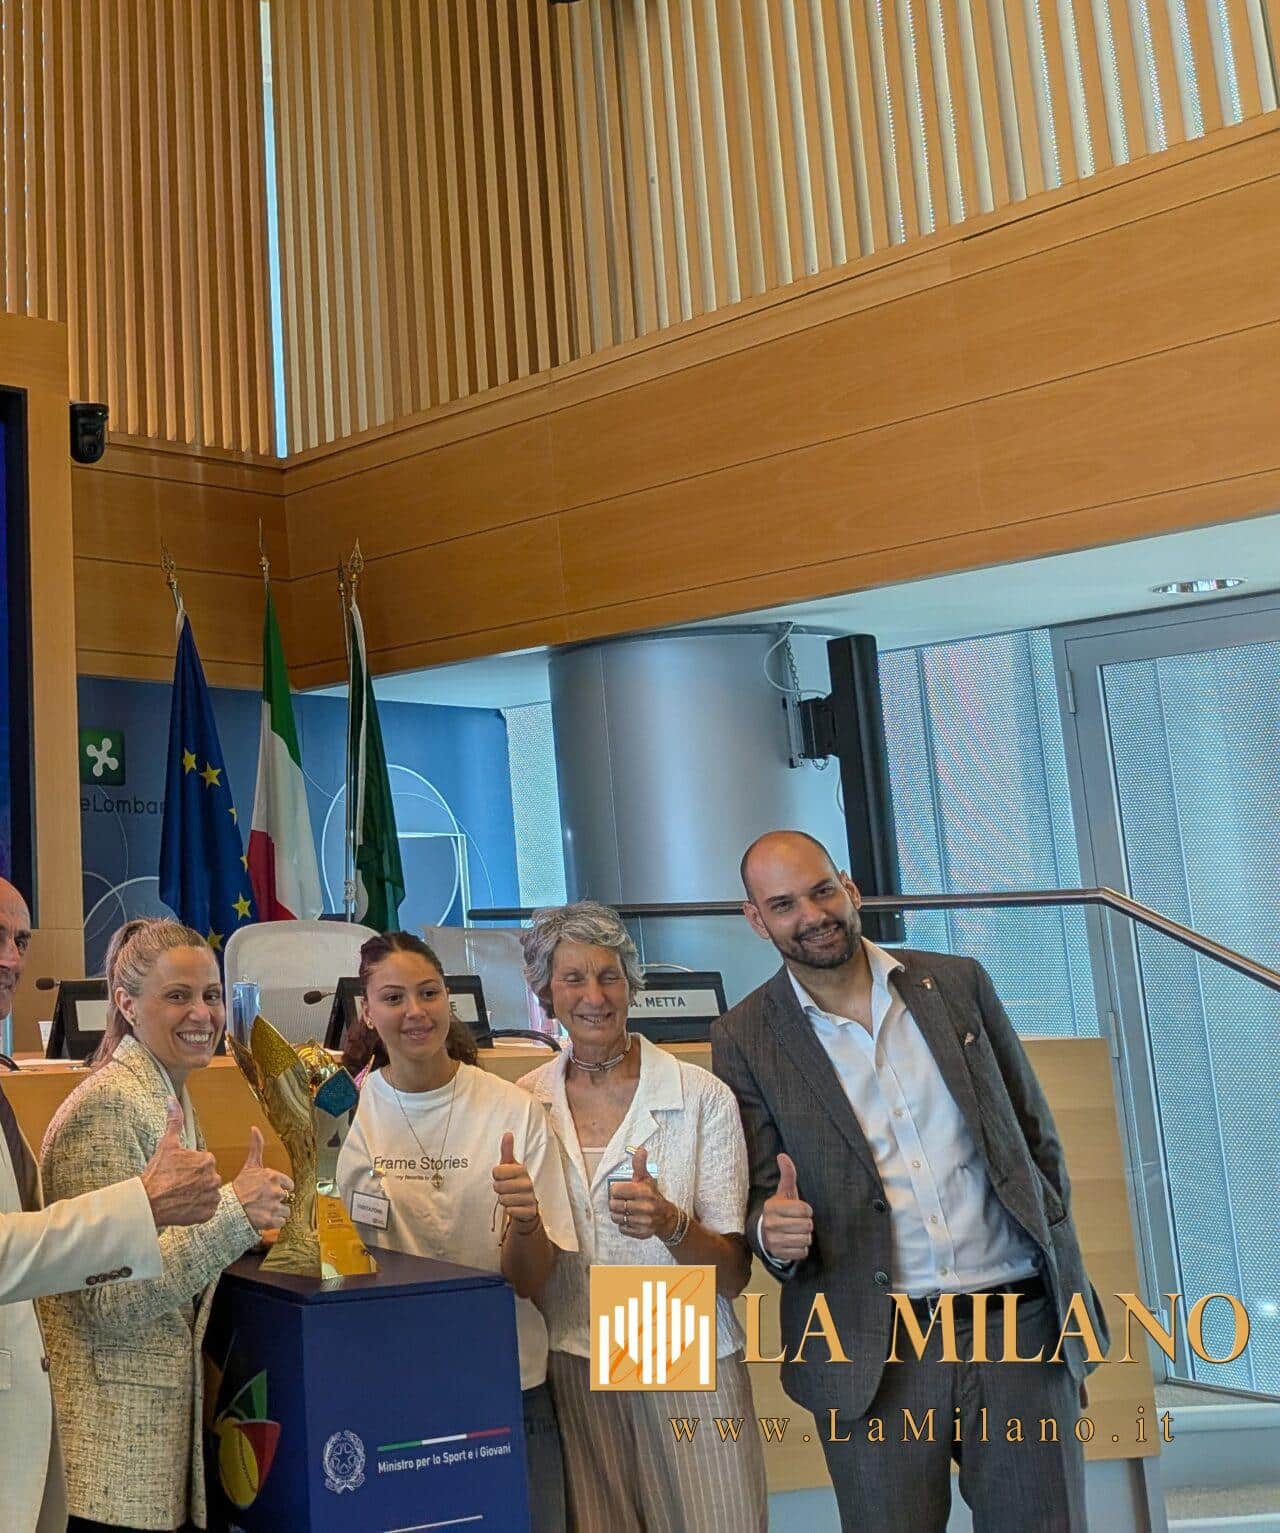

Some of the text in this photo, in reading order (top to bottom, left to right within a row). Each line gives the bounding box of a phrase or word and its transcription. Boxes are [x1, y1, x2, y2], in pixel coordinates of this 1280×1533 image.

[644, 996, 686, 1008] METTA
[373, 1155, 469, 1170] Frame Stories
[378, 1460, 414, 1473] Ministro
[416, 1457, 430, 1470] per
[433, 1454, 440, 1465] lo
[443, 1450, 466, 1464] Sport
[480, 1442, 511, 1457] Giovani
